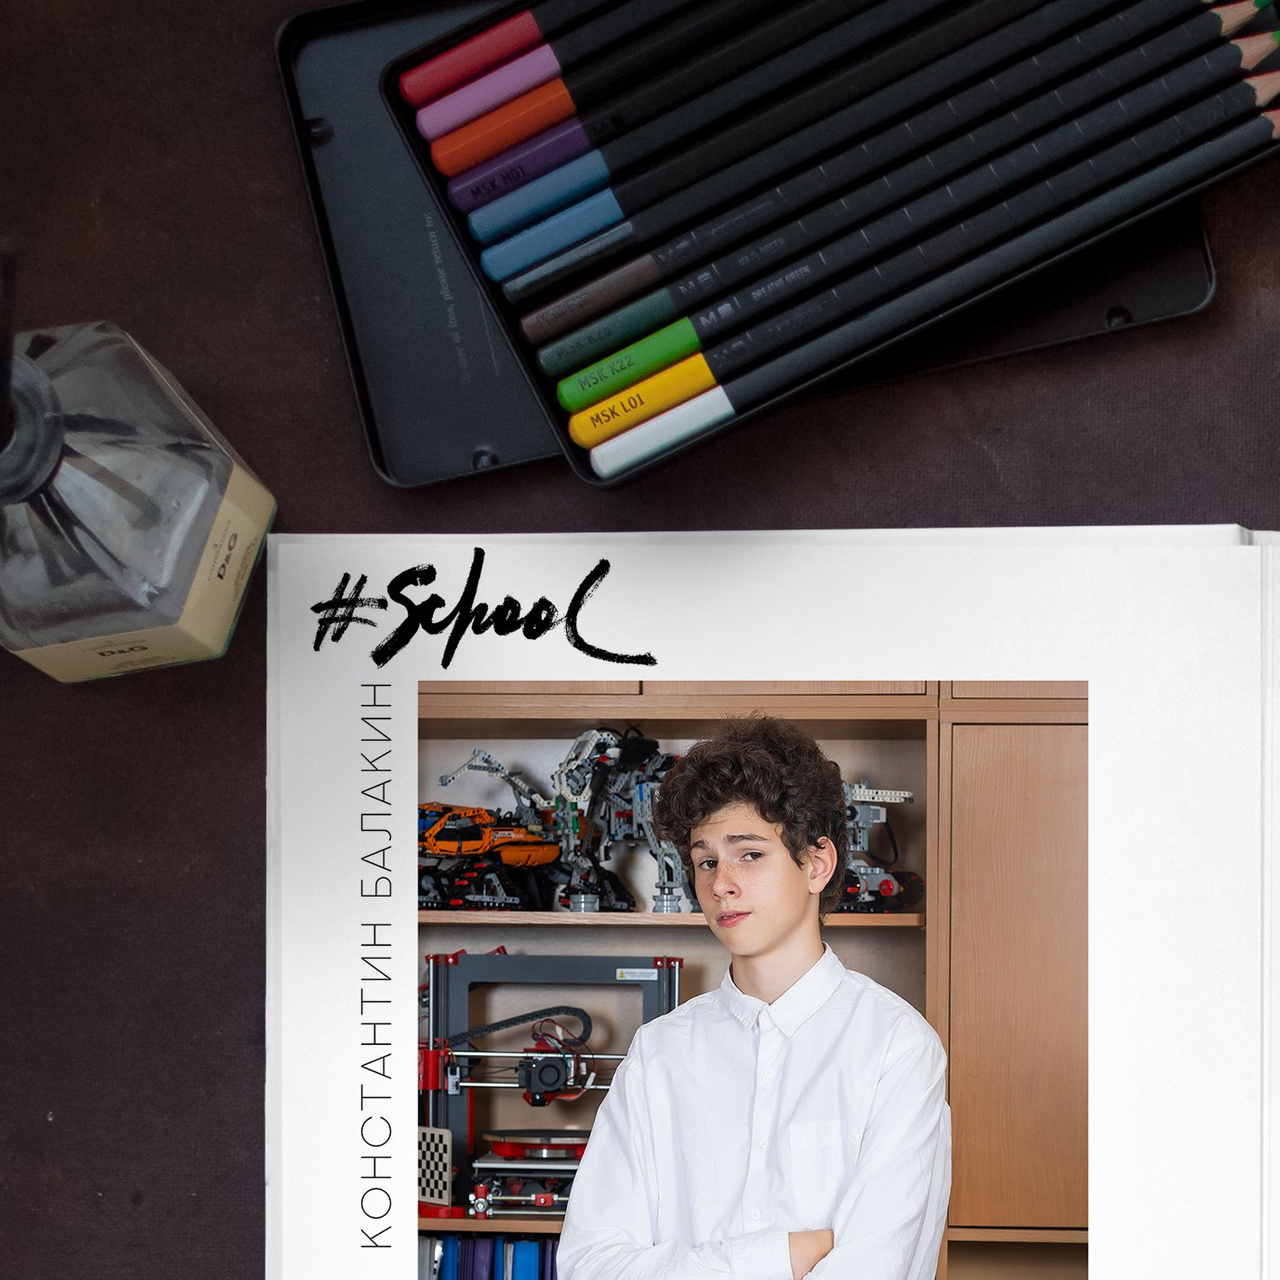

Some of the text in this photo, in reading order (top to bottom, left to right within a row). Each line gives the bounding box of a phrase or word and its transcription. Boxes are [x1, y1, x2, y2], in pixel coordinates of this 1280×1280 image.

[577, 353, 635, 391] MSK K22
[589, 407, 621, 430] MSK
[359, 682, 393, 1249] КОНСТАНТИН БАЛАКИН
